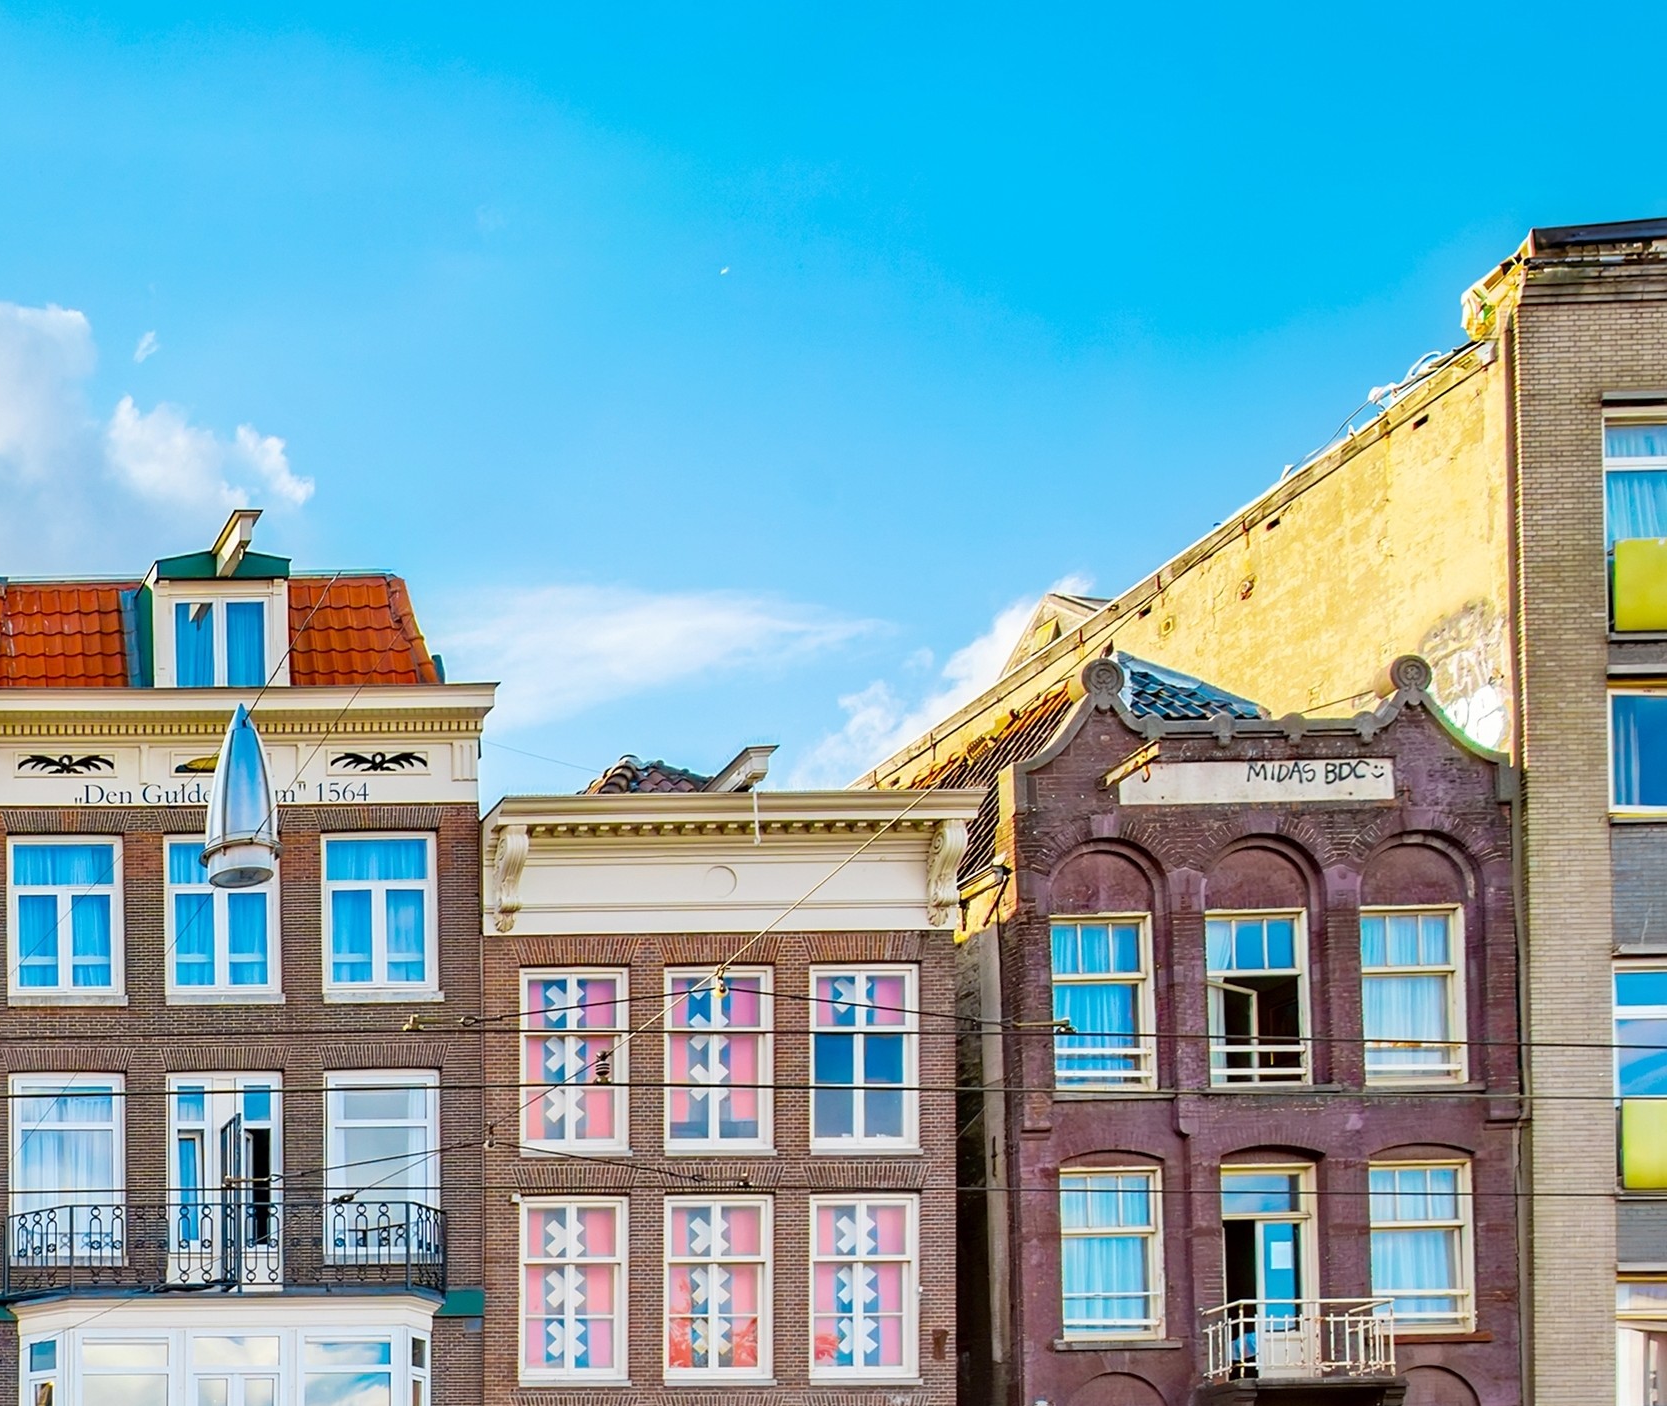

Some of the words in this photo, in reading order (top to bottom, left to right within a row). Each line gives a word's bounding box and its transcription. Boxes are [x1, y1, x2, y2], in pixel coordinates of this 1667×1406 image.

[1247, 762, 1316, 783] MIDAS
[1324, 760, 1371, 784] BDC
[142, 783, 212, 804] Gulde
[315, 782, 369, 802] 1564
